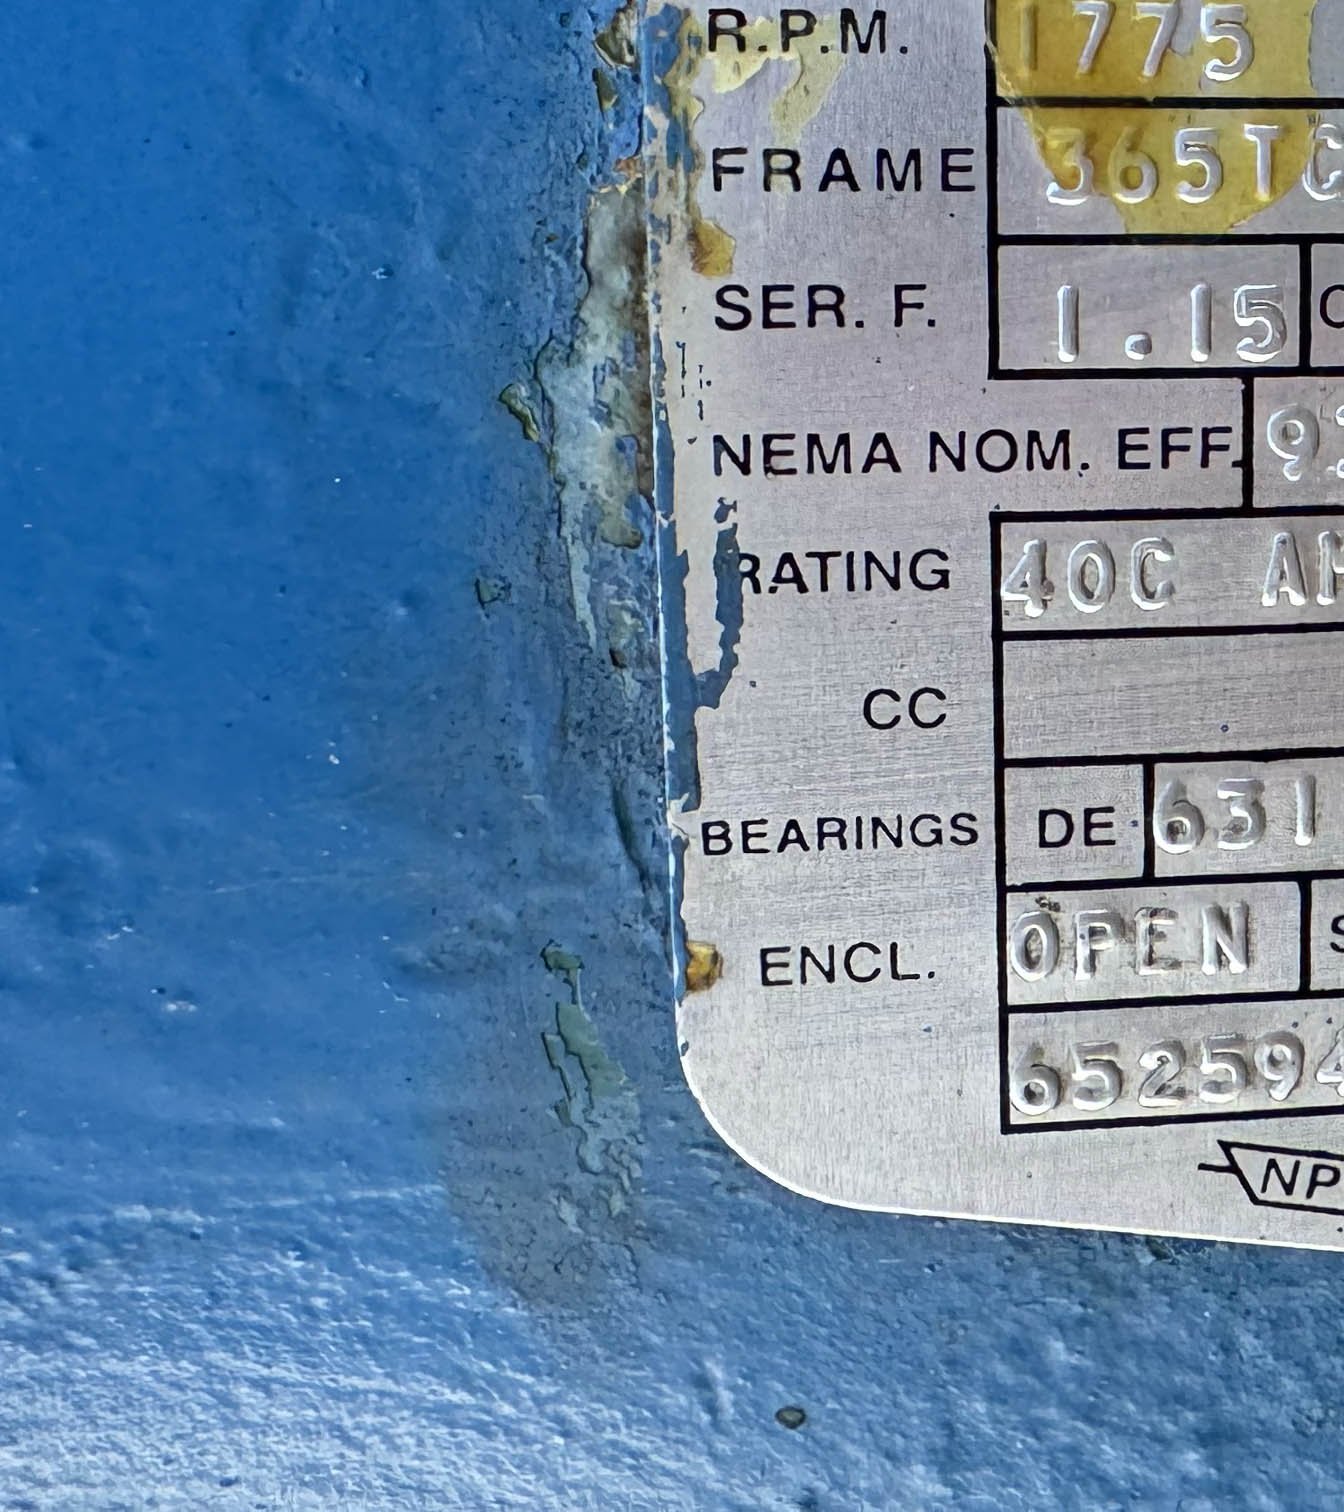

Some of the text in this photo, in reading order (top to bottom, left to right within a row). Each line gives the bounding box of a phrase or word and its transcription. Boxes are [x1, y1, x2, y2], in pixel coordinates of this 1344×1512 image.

[708, 7, 908, 54] R.P.M.
[711, 148, 976, 192] FRAME
[714, 285, 865, 331] SER.
[892, 286, 936, 329] F.
[1055, 284, 1287, 362] 1.15
[712, 433, 900, 477] NEMA
[930, 430, 1090, 473] NOM.
[738, 549, 949, 594] RATING
[1001, 537, 1177, 617] 40C
[863, 687, 947, 729] CC
[701, 813, 980, 856] BEARINGS
[1038, 807, 1117, 850] DE
[760, 942, 935, 988] ENCL.
[1008, 901, 1250, 982] OPEN
